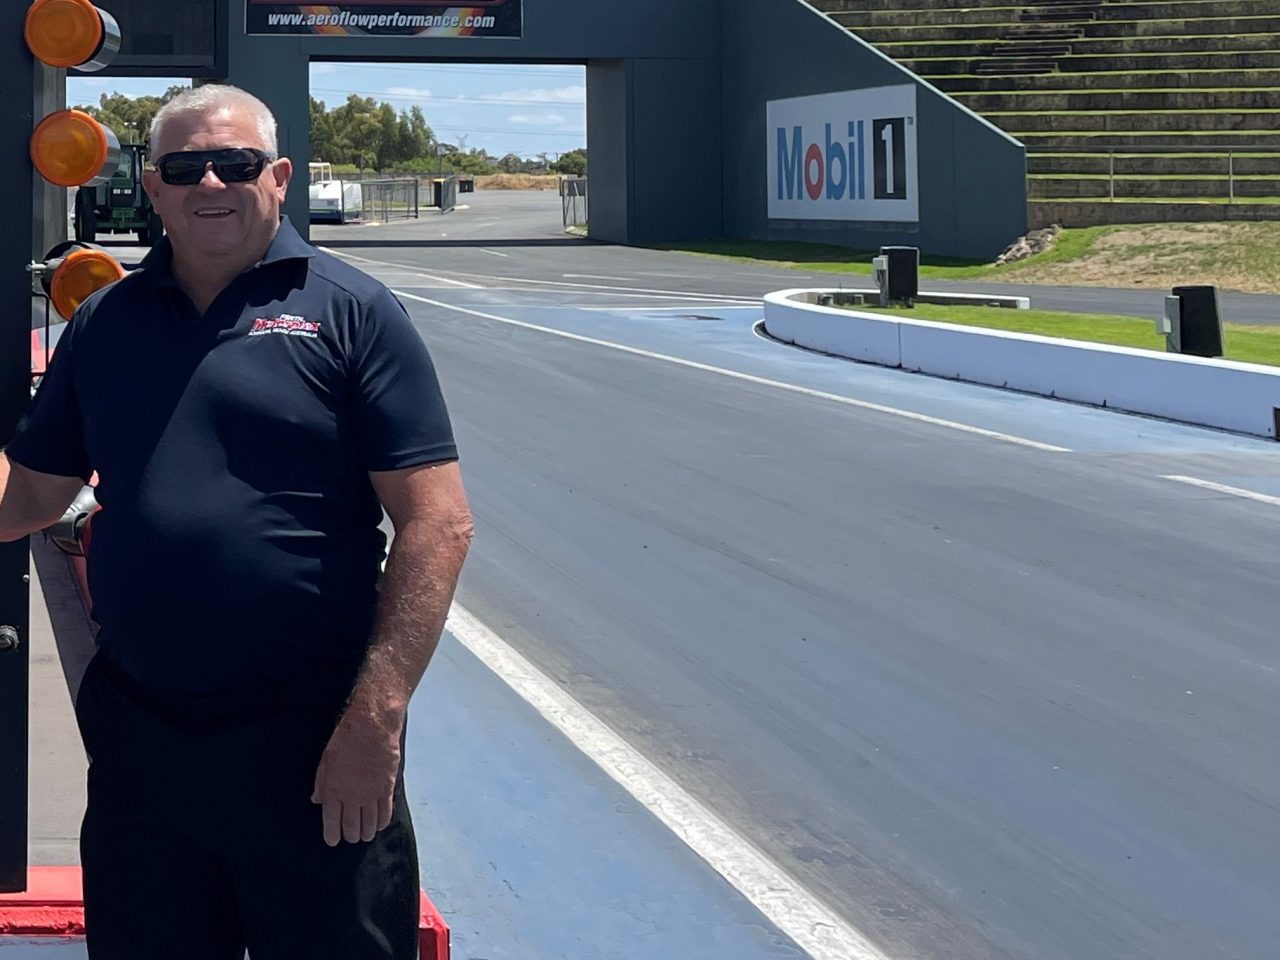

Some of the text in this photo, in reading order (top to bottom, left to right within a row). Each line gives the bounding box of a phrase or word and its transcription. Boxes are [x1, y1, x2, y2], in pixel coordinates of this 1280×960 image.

[268, 11, 495, 29] www.aeroflowperformance.com
[777, 120, 897, 201] Mobil 1
